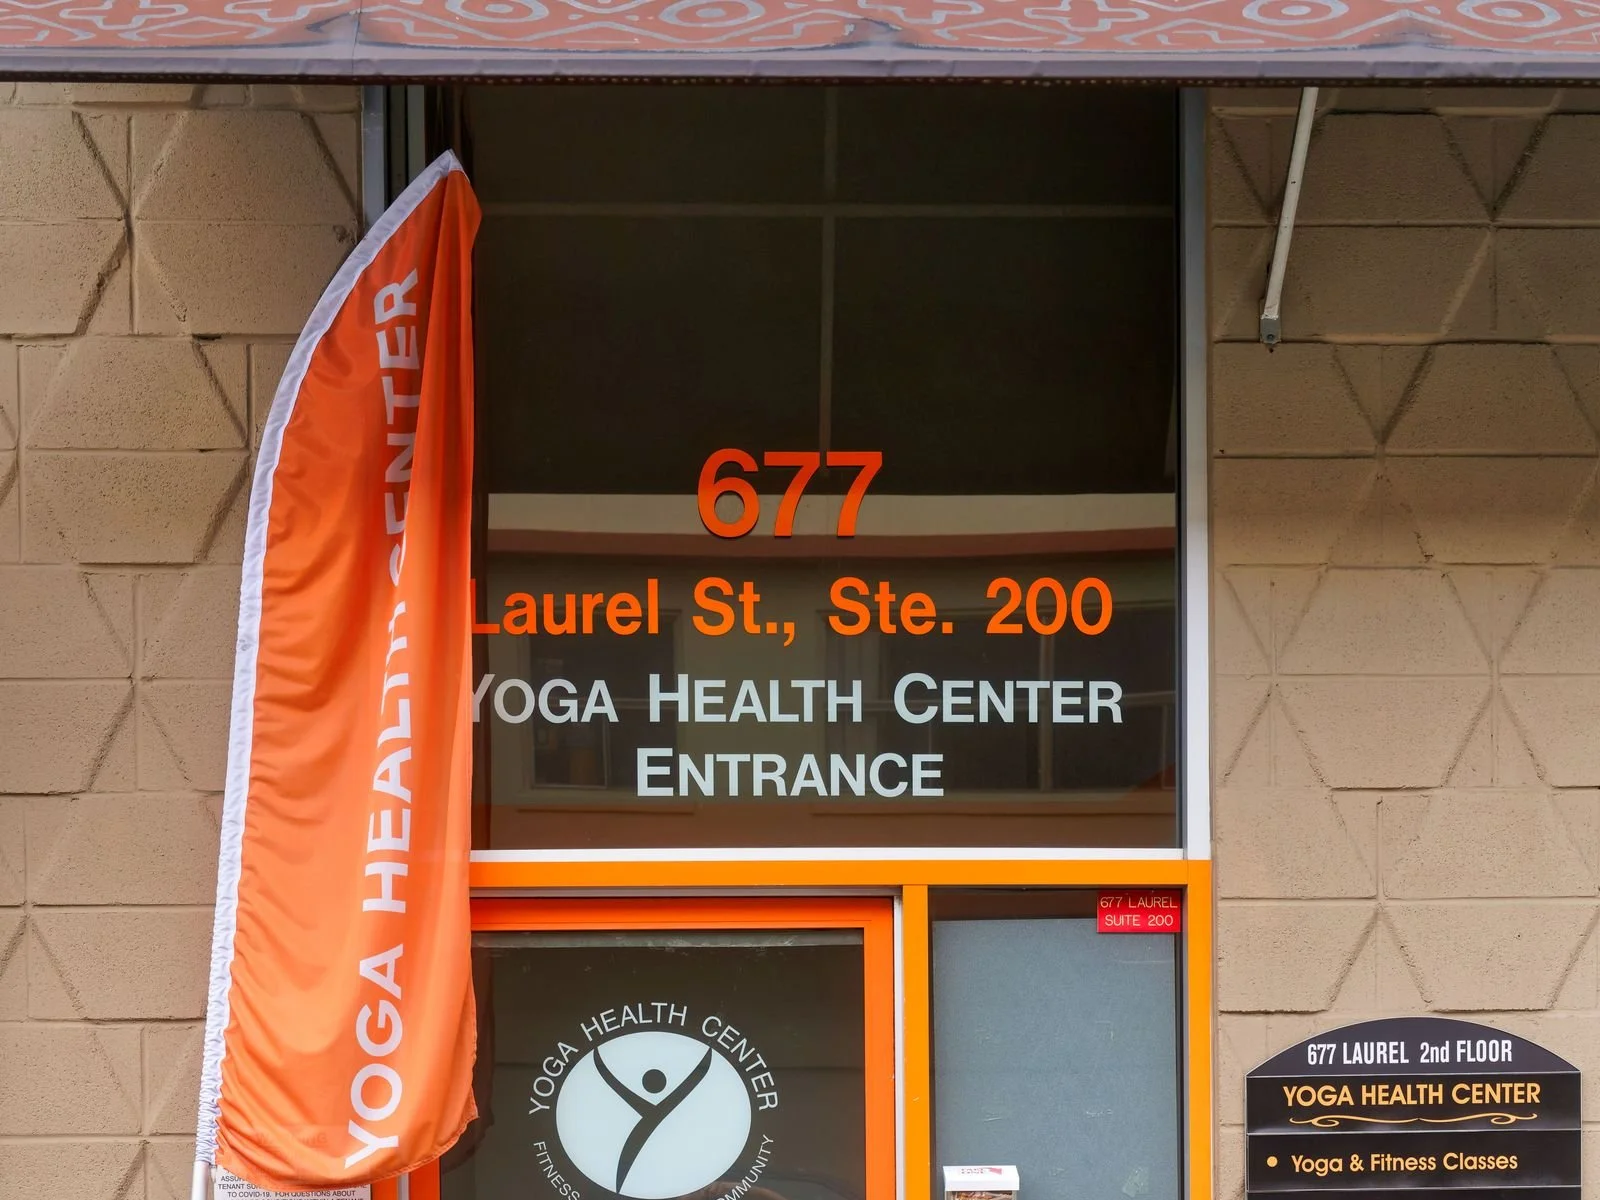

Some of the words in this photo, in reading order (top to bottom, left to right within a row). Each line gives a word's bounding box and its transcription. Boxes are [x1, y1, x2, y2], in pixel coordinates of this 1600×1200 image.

[698, 447, 884, 538] 677
[470, 578, 660, 636] Laurel
[692, 577, 797, 647] St.,
[829, 577, 954, 636] Ste.
[986, 577, 1114, 636] 200
[471, 673, 619, 724] YOGA
[648, 673, 863, 723] HEALTH
[893, 672, 1124, 725] CENTER
[636, 747, 945, 798] ENTRANCE
[1100, 896, 1123, 908] 677
[1128, 896, 1178, 908] LAUREL
[1104, 914, 1141, 926] SUITE
[1147, 914, 1174, 926] 200
[344, 943, 405, 1169] YOGA
[528, 1040, 580, 1116] YOGA
[580, 1002, 688, 1042] HEALTH
[701, 1015, 779, 1111] CENTER
[1307, 1043, 1337, 1065] 677
[1342, 1041, 1409, 1064] LAUREL
[1419, 1040, 1449, 1063] 2nd
[1456, 1039, 1513, 1063] FLOOR
[1283, 1085, 1355, 1107] YOGA
[1361, 1084, 1443, 1106] HEALTH
[1451, 1082, 1541, 1104] CENTER
[1291, 1154, 1343, 1177] Yoga
[1349, 1154, 1364, 1172] &
[1370, 1153, 1436, 1172] Fitness
[1442, 1152, 1518, 1170] Classes
